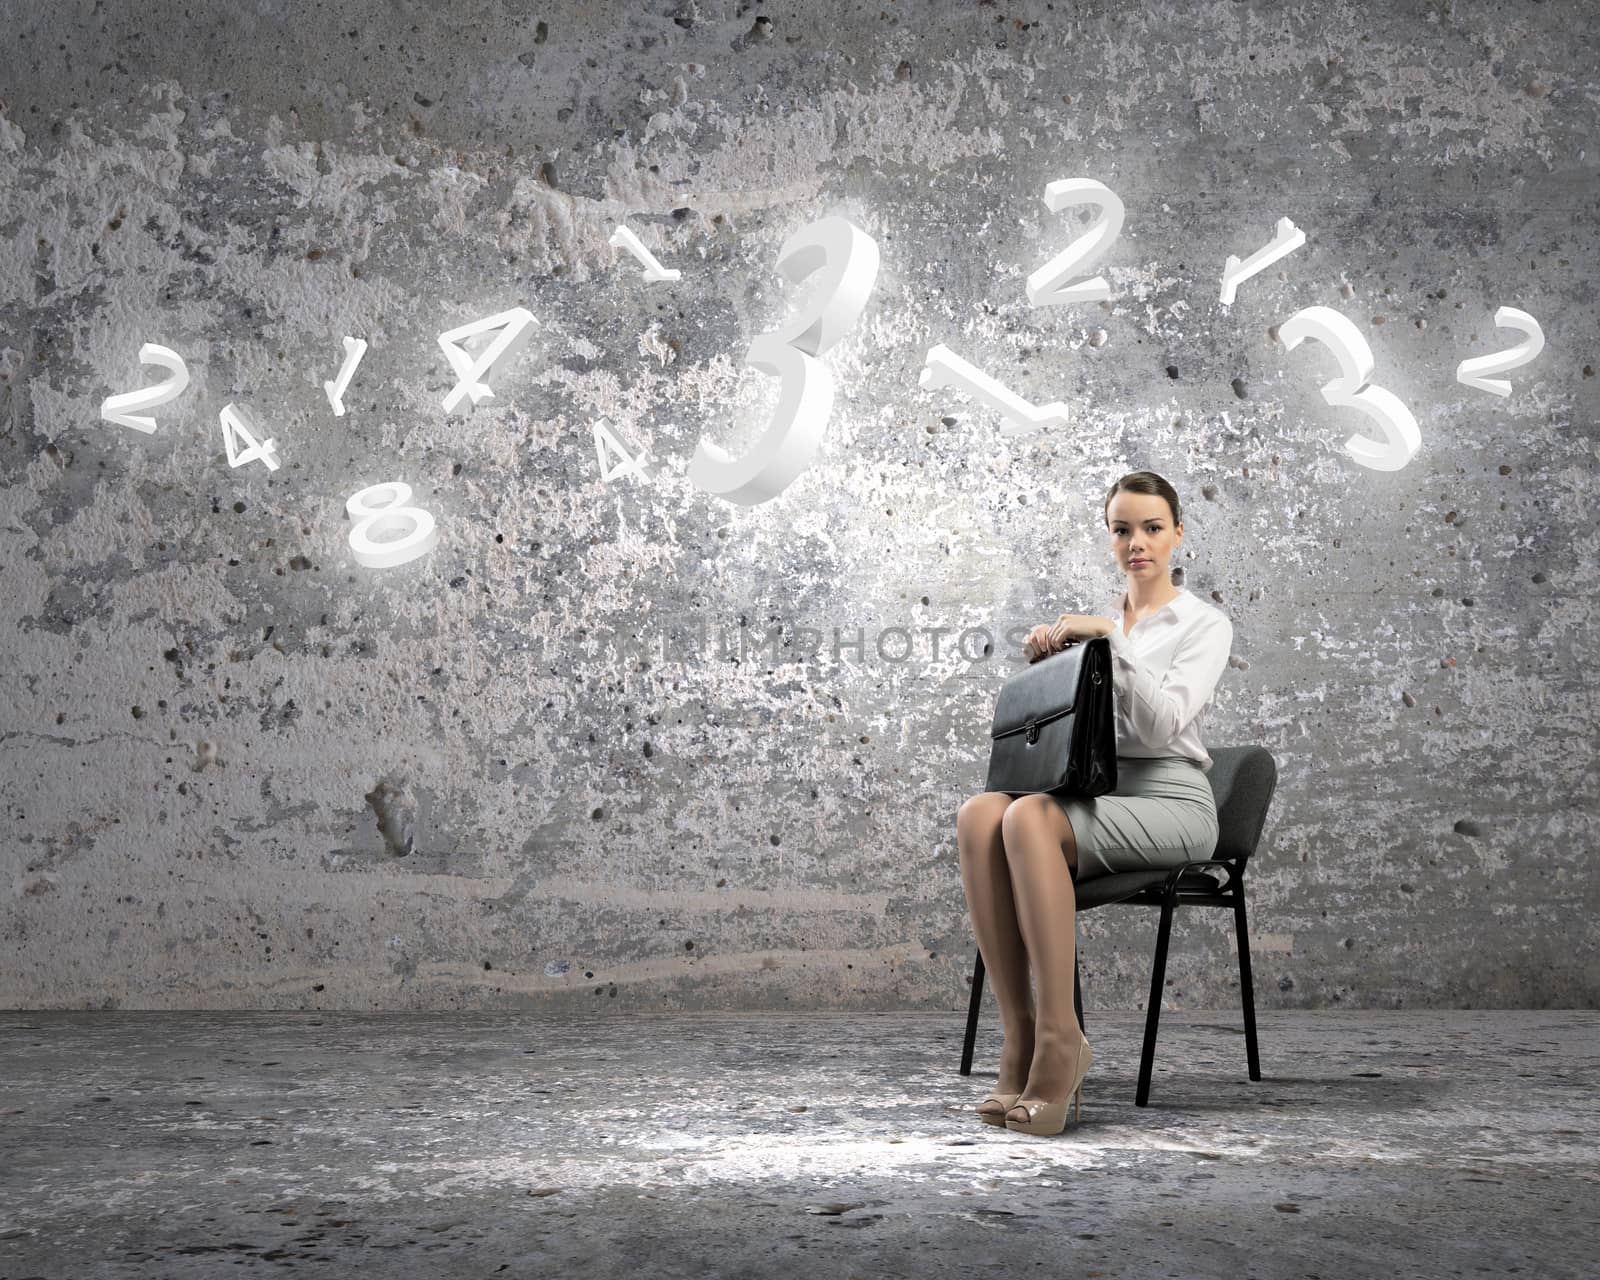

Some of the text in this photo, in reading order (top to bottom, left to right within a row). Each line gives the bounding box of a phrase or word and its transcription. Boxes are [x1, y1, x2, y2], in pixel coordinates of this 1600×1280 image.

[609, 225, 681, 281] 1
[1026, 177, 1125, 306] 2
[1219, 215, 1306, 304] 1
[101, 342, 189, 434] 2
[324, 336, 367, 416] 1
[438, 307, 539, 414] 4
[687, 216, 880, 507] 3
[918, 343, 1068, 434] 1
[1278, 306, 1421, 471] 3
[1457, 306, 1546, 398] 2
[219, 402, 280, 471] 4
[593, 417, 652, 485] 4
[346, 482, 439, 568] 8
